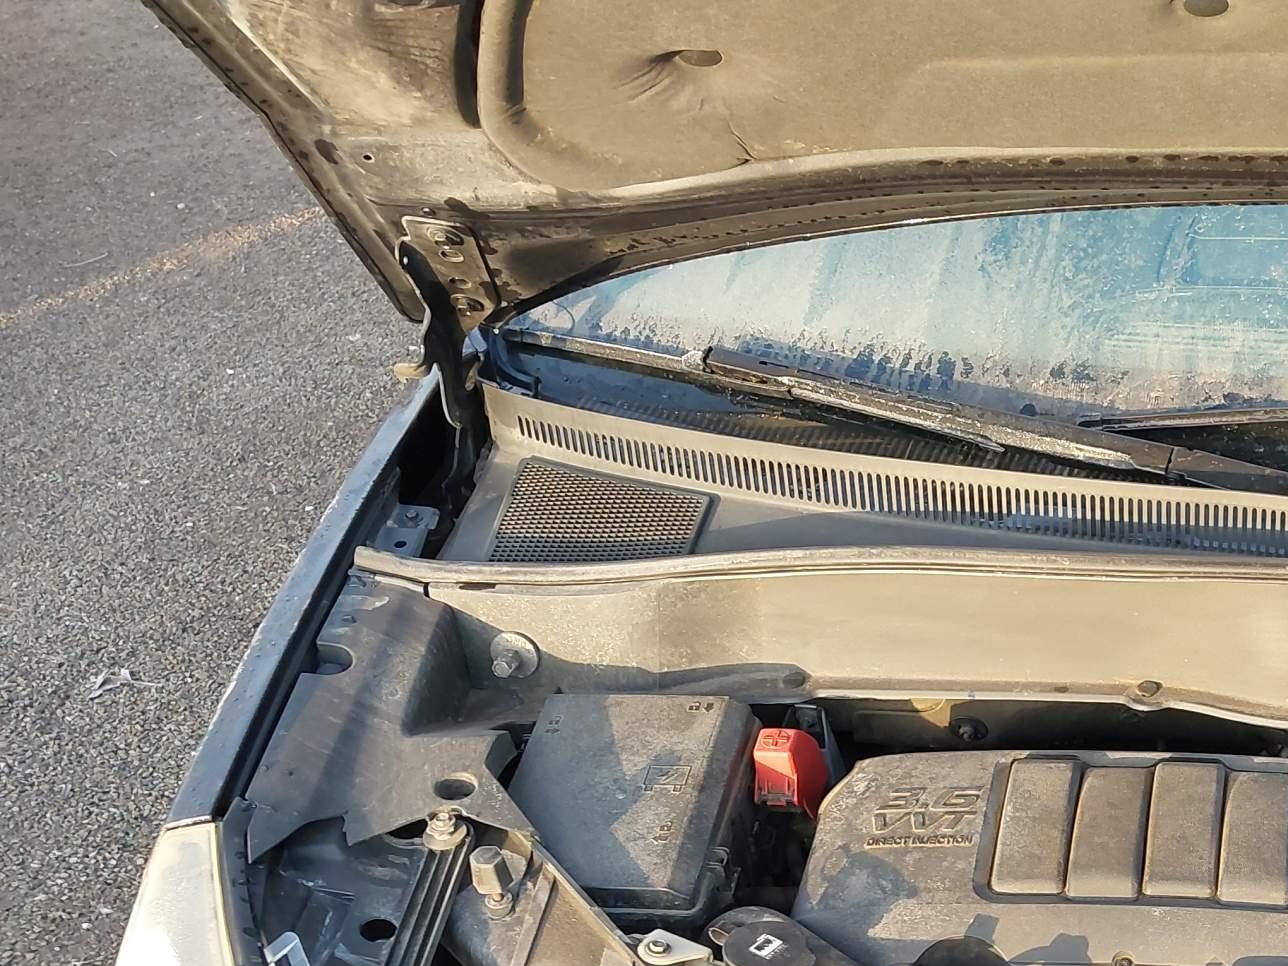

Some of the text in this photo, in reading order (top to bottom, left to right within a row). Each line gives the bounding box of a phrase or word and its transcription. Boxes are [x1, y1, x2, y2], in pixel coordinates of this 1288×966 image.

[875, 786, 984, 810] 3.6
[872, 810, 978, 833] VVT
[865, 834, 974, 848] DIRECT INJECTION
